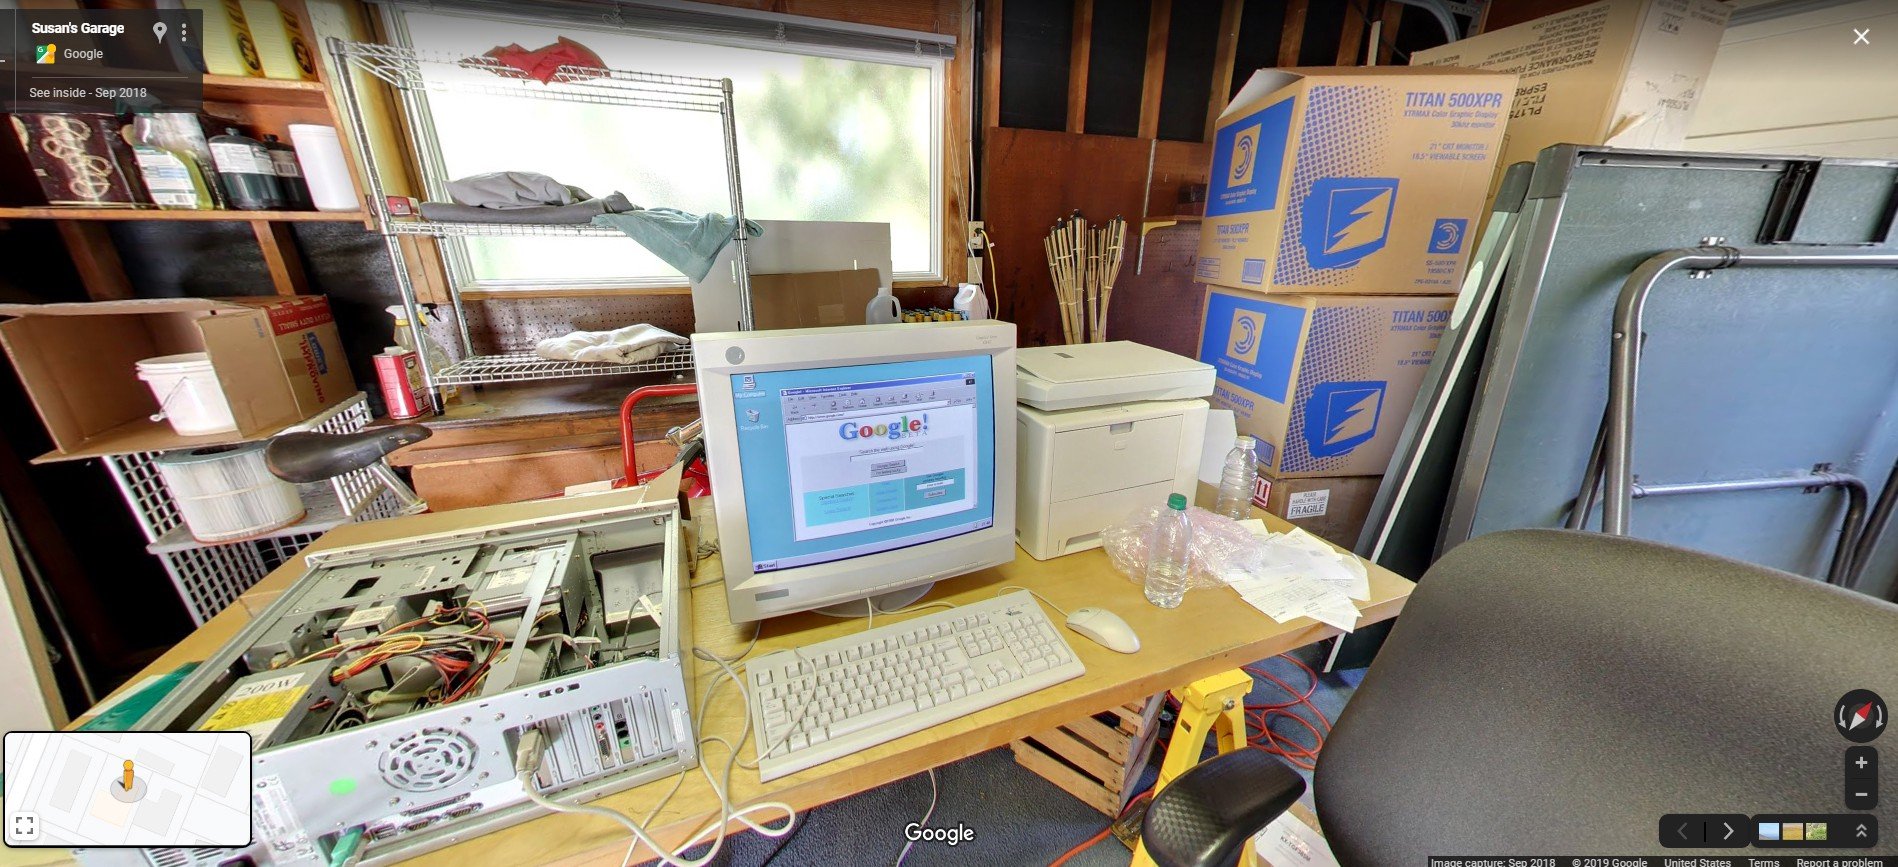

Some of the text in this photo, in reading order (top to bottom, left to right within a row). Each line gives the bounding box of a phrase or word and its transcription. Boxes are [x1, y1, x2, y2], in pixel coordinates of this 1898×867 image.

[1544, 24, 1562, 33] CARE
[1555, 38, 1584, 49] PRODUCT
[1528, 49, 1597, 71] PERFORMANCE
[1406, 92, 1502, 108] TITAN 500XPR
[1431, 110, 1448, 118] Color
[1449, 110, 1473, 119] Graphic
[1474, 110, 1498, 119] Display
[1392, 311, 1424, 323] TITAN
[838, 414, 928, 440] Google!
[901, 431, 928, 439] BETA
[1291, 504, 1324, 515] FRAGILE
